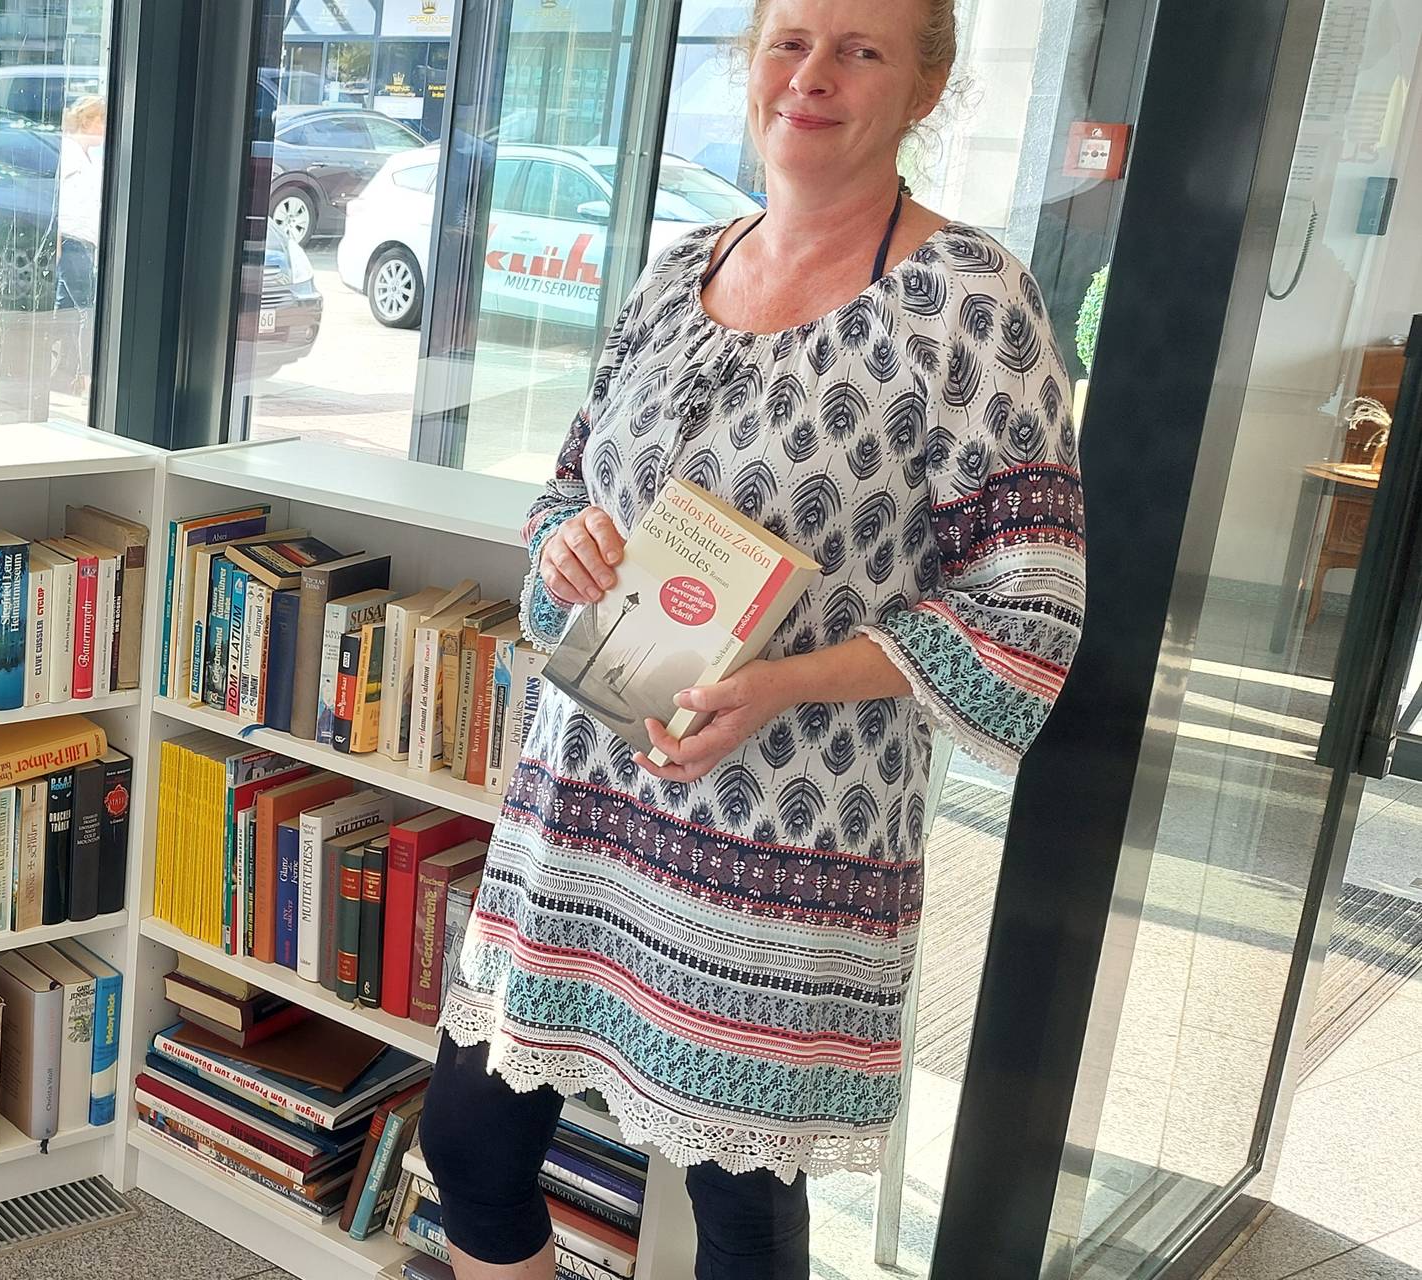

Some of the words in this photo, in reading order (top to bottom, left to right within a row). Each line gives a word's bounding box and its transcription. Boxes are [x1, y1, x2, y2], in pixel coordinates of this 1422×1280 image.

[505, 275, 602, 302] MULTISERVICES
[653, 501, 679, 524] Der
[678, 517, 731, 564] Schatten
[665, 486, 703, 520] Carlos
[704, 513, 732, 540] Ruiz
[732, 533, 771, 569] Zafón
[643, 518, 663, 538] des
[665, 531, 710, 573] Windes
[3, 554, 14, 579] Lenz
[1, 581, 13, 626] Siegfried
[10, 553, 23, 632] Heimatmuseum
[37, 587, 46, 616] CYCLOP
[216, 567, 227, 619] Kulturführer
[36, 619, 44, 651] CUSSLER
[78, 600, 93, 668] Bauernregeln
[232, 605, 243, 663] LATIUM
[253, 605, 262, 638] Burgund
[35, 653, 43, 676] CLIVE
[213, 626, 223, 684] Griechenland
[227, 676, 240, 710] ROM
[510, 724, 520, 746] John
[16, 748, 64, 774] Palmer
[66, 742, 89, 764] Lilli
[280, 856, 289, 883] Glanz
[304, 839, 314, 878] TERESA
[301, 881, 313, 923] MUTTER
[419, 889, 438, 970] Geschworene
[76, 983, 91, 993] GARY
[418, 970, 431, 989] Die
[162, 1041, 213, 1074] Düsenantrieb
[213, 1064, 231, 1081] zum
[232, 1073, 270, 1101] Propeller
[270, 1091, 289, 1109] Vom
[294, 1103, 326, 1127] Fliegen
[368, 1178, 380, 1191] Der
[588, 1198, 637, 1231] MICHAEL
